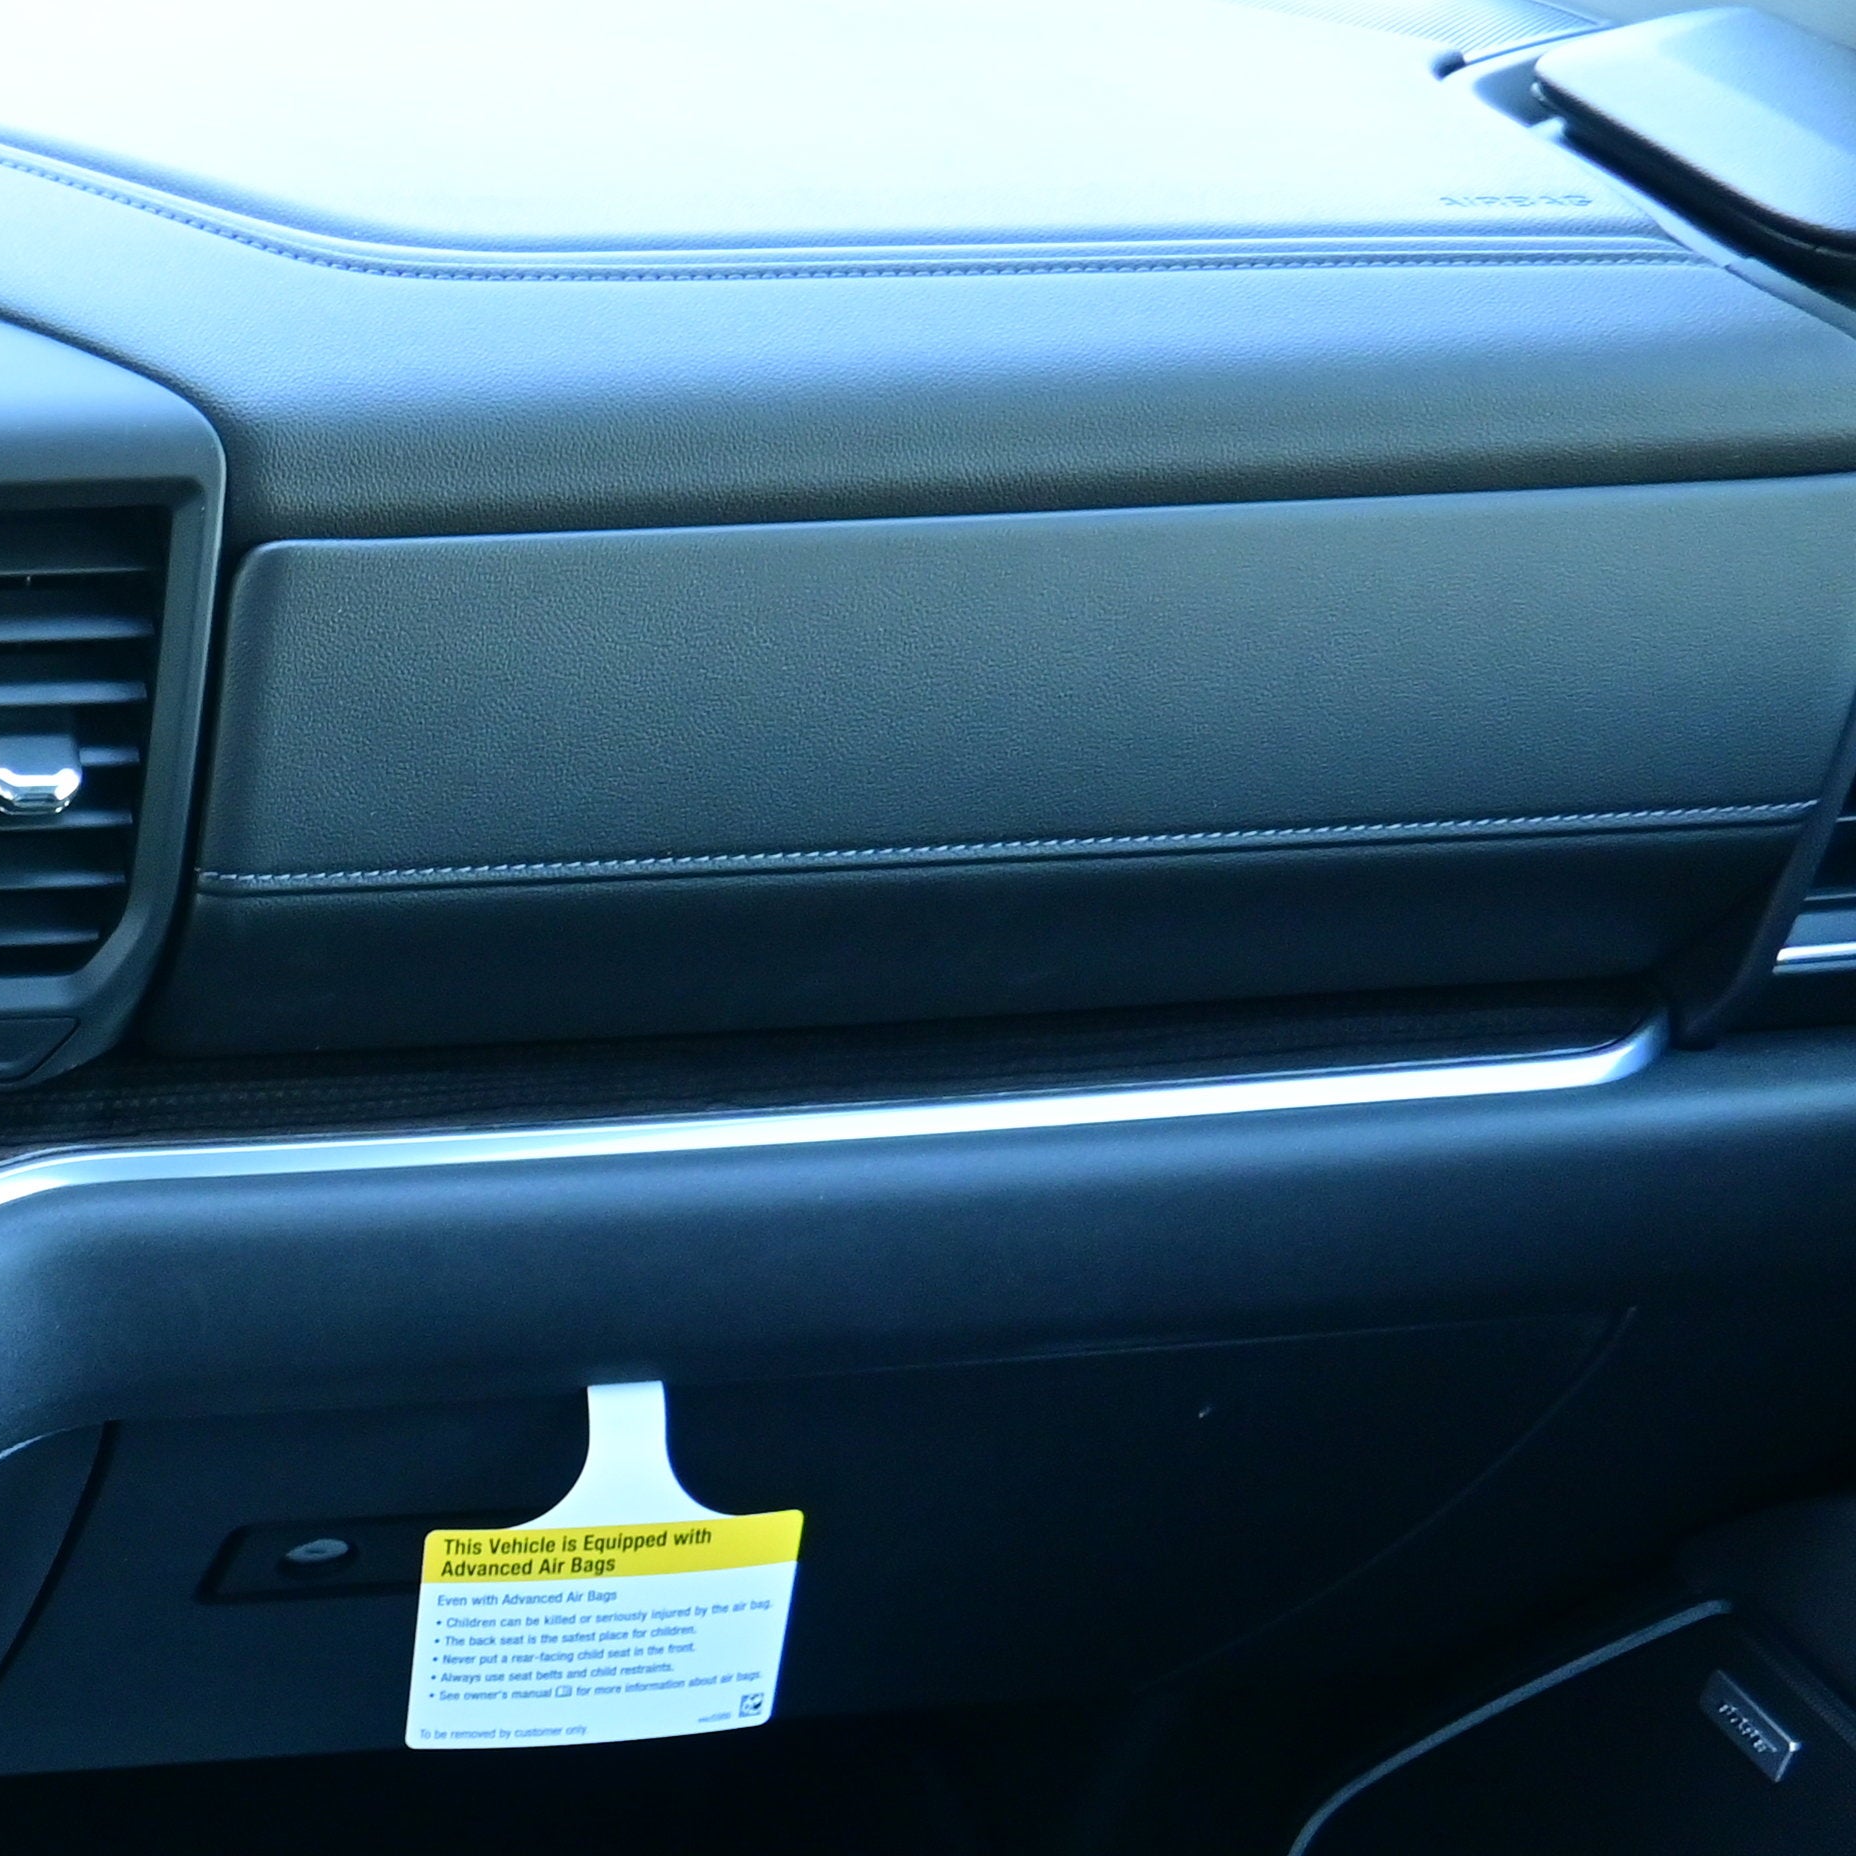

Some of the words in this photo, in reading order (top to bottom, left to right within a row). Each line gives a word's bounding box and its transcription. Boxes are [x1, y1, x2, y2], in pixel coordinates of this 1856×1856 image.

[444, 1537, 483, 1556] This
[488, 1536, 556, 1555] Vehicle
[561, 1535, 577, 1552] is
[583, 1531, 668, 1554] Equipped
[673, 1528, 712, 1546] with
[441, 1559, 533, 1577] Advanced
[538, 1558, 566, 1574] Air
[570, 1556, 616, 1576] Bags
[437, 1594, 467, 1607] Even
[471, 1594, 499, 1606] with
[502, 1592, 562, 1606] Advanced
[566, 1591, 583, 1603] Air
[587, 1590, 617, 1603] Bags
[446, 1617, 496, 1628] Children
[500, 1618, 522, 1627] can
[525, 1616, 539, 1627] be
[543, 1615, 576, 1626] killed
[580, 1615, 592, 1624] or
[595, 1610, 648, 1623] seriously
[651, 1607, 691, 1621] injured
[694, 1606, 708, 1617] by
[711, 1603, 728, 1614] the
[732, 1602, 747, 1612] air
[445, 1636, 465, 1646] The
[469, 1635, 496, 1646] back
[500, 1635, 524, 1645] seat
[527, 1634, 537, 1644] is
[540, 1633, 558, 1644] the
[561, 1632, 596, 1643] safest
[599, 1629, 629, 1642] place
[632, 1628, 647, 1638] for
[650, 1625, 696, 1638] children.
[442, 1654, 476, 1665] Never
[479, 1654, 498, 1665] put
[511, 1651, 574, 1664] rear-facing
[577, 1649, 604, 1661] child
[607, 1648, 631, 1659] seat
[634, 1647, 644, 1657] in
[647, 1645, 665, 1656] the
[668, 1642, 695, 1654] front.
[440, 1672, 481, 1684] Always
[485, 1673, 505, 1682] use
[508, 1671, 533, 1681] seat
[536, 1669, 563, 1681] belts
[566, 1667, 587, 1679] and
[590, 1666, 617, 1678] child
[620, 1663, 674, 1676] restraints.
[439, 1690, 460, 1701] See
[463, 1689, 508, 1700] owner's
[511, 1688, 552, 1699] manual
[576, 1686, 591, 1696] for
[594, 1684, 622, 1695] more
[625, 1679, 685, 1693] information
[688, 1675, 718, 1687] about
[720, 1673, 734, 1684] air
[420, 1729, 431, 1739] To
[434, 1729, 447, 1739] be
[450, 1728, 496, 1739] removed
[499, 1728, 511, 1739] by
[514, 1727, 562, 1738] customer
